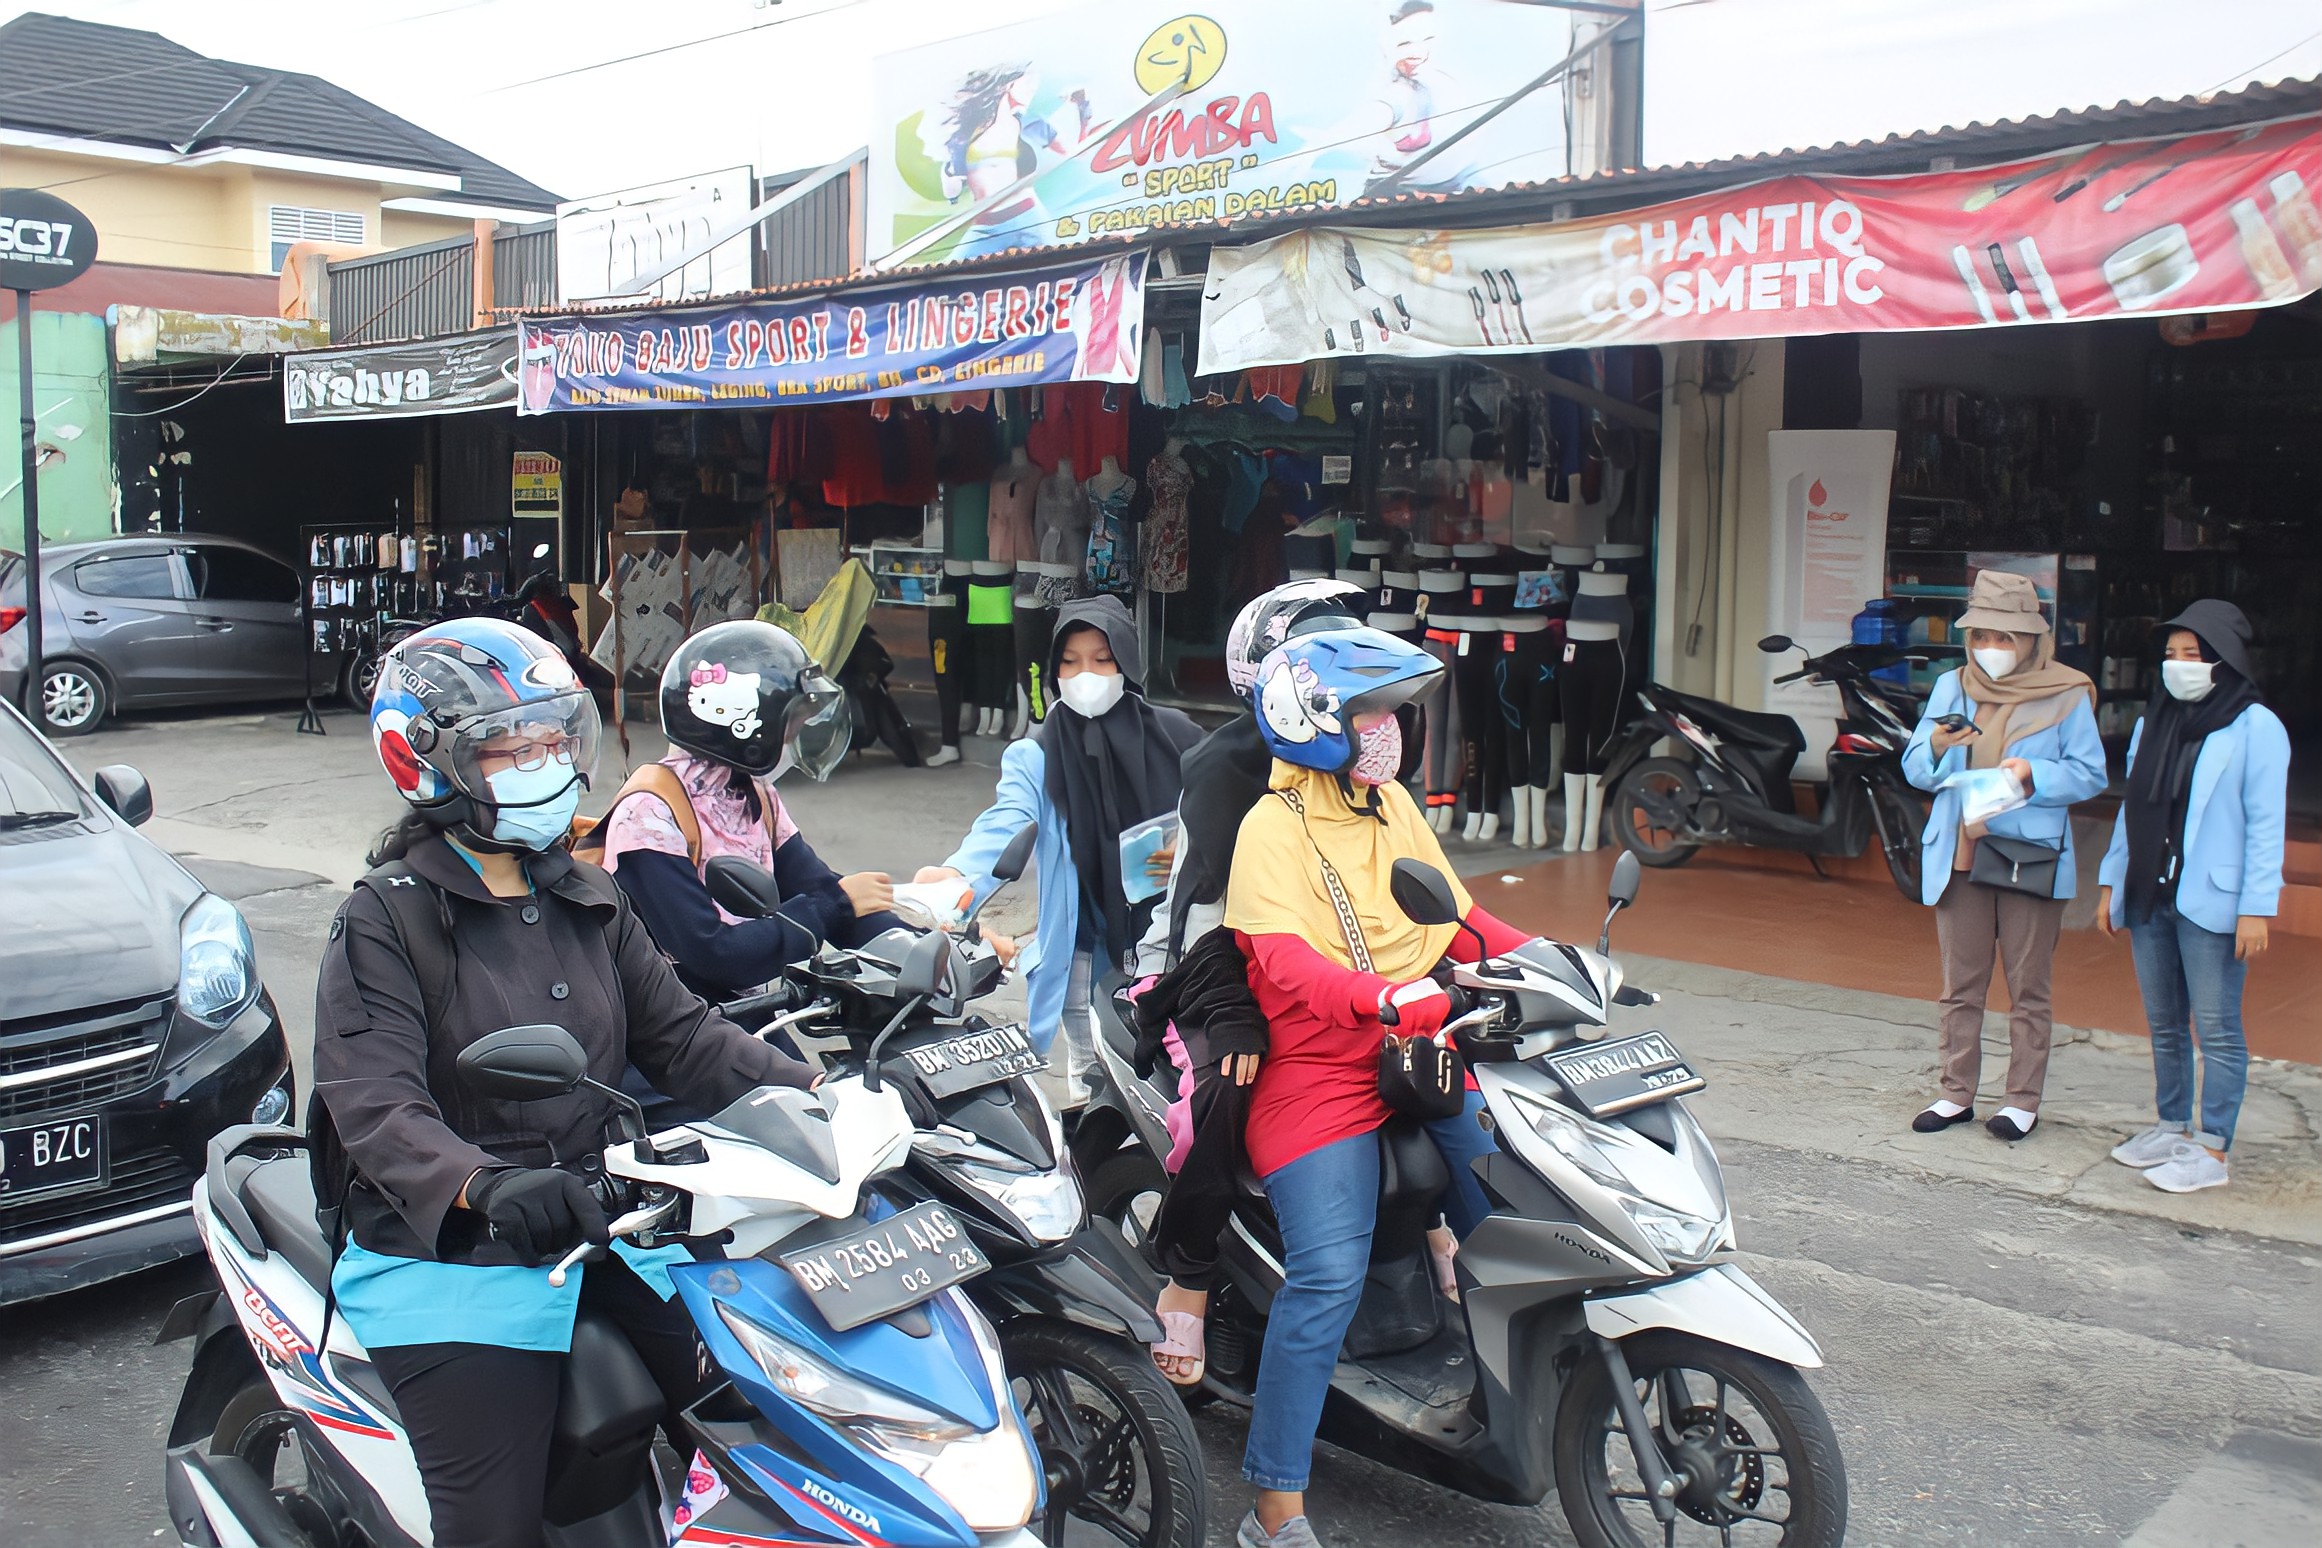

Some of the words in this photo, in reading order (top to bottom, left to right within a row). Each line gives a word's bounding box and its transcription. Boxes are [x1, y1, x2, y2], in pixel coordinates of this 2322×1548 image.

[1090, 92, 1277, 173] ZUMBA
[1056, 216, 1080, 238] &
[1088, 196, 1215, 234] PAKAIAN
[1224, 179, 1336, 217] DALAM
[1600, 199, 1865, 268] CHANTIQ
[1580, 255, 1885, 325] COSMETIC
[726, 311, 831, 369] SPORT
[846, 307, 869, 359] &
[885, 278, 1077, 355] LINGERIE
[33, 1122, 91, 1168] BZC
[793, 1255, 851, 1292] BM
[836, 1231, 908, 1279] 2584
[901, 1267, 932, 1292] 03
[949, 1247, 978, 1271] 23
[801, 1478, 881, 1535] HONDA
